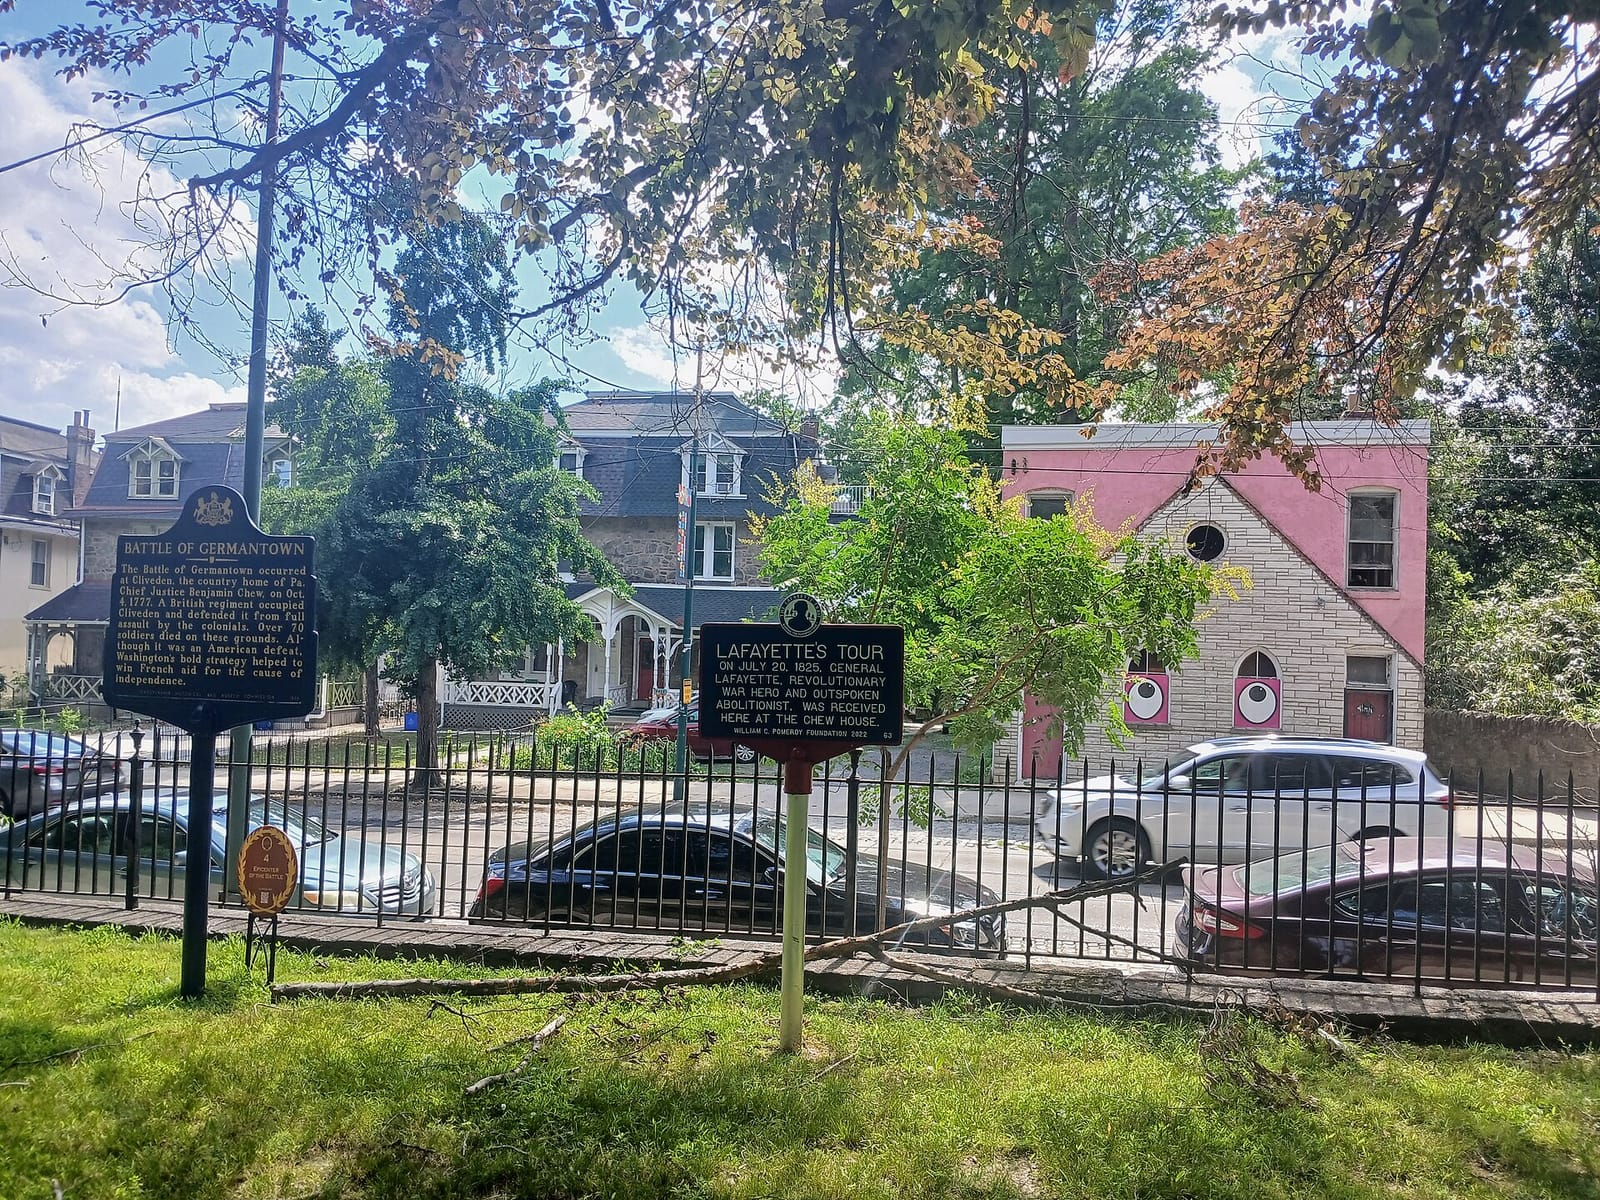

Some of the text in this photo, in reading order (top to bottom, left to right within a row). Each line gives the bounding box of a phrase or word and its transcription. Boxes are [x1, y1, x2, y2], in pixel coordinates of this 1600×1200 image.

[125, 543, 305, 555] BATTLE OF GERMANTOWN
[121, 564, 306, 575] The Battle of Germantown occurred
[120, 576, 130, 585] at
[179, 576, 195, 585] the
[198, 577, 237, 588] country
[243, 577, 268, 586] home
[274, 578, 286, 587] of
[291, 578, 305, 587] Pa.
[120, 587, 145, 596] Chief
[150, 587, 185, 596] Justice
[190, 588, 233, 598] Benjamin
[270, 590, 282, 598] on
[286, 589, 305, 598] Oct.
[130, 598, 153, 607] 1777.
[159, 599, 166, 607] A
[170, 599, 204, 608] British
[209, 600, 254, 610] regiment
[259, 601, 304, 611] occupied
[118, 609, 304, 621] Cliveden and defended it from full
[118, 620, 304, 632] assault by the colonials. Over 70
[117, 631, 304, 644] soldiers died on these grounds. Al-
[117, 642, 150, 654] though
[155, 642, 162, 651] it
[168, 644, 185, 652] was
[208, 644, 257, 654] American
[716, 642, 884, 659] LAFAYETTE'S TOUR
[116, 652, 303, 668] Washington's bold strategy helped to
[116, 664, 302, 678] win French aid for the cause of
[739, 662, 766, 671] JULY
[830, 663, 884, 673] GENERAL
[115, 675, 186, 687] independence.
[789, 676, 886, 687] REVOLUTIONARY
[722, 687, 879, 700] WAR HERO AND OUTSPOKEN
[802, 702, 825, 712] WAS
[831, 703, 886, 713] RECEIVED
[721, 713, 880, 727] HERE AT THE CHEW HOUSE.
[806, 729, 847, 737] FOUNDATION
